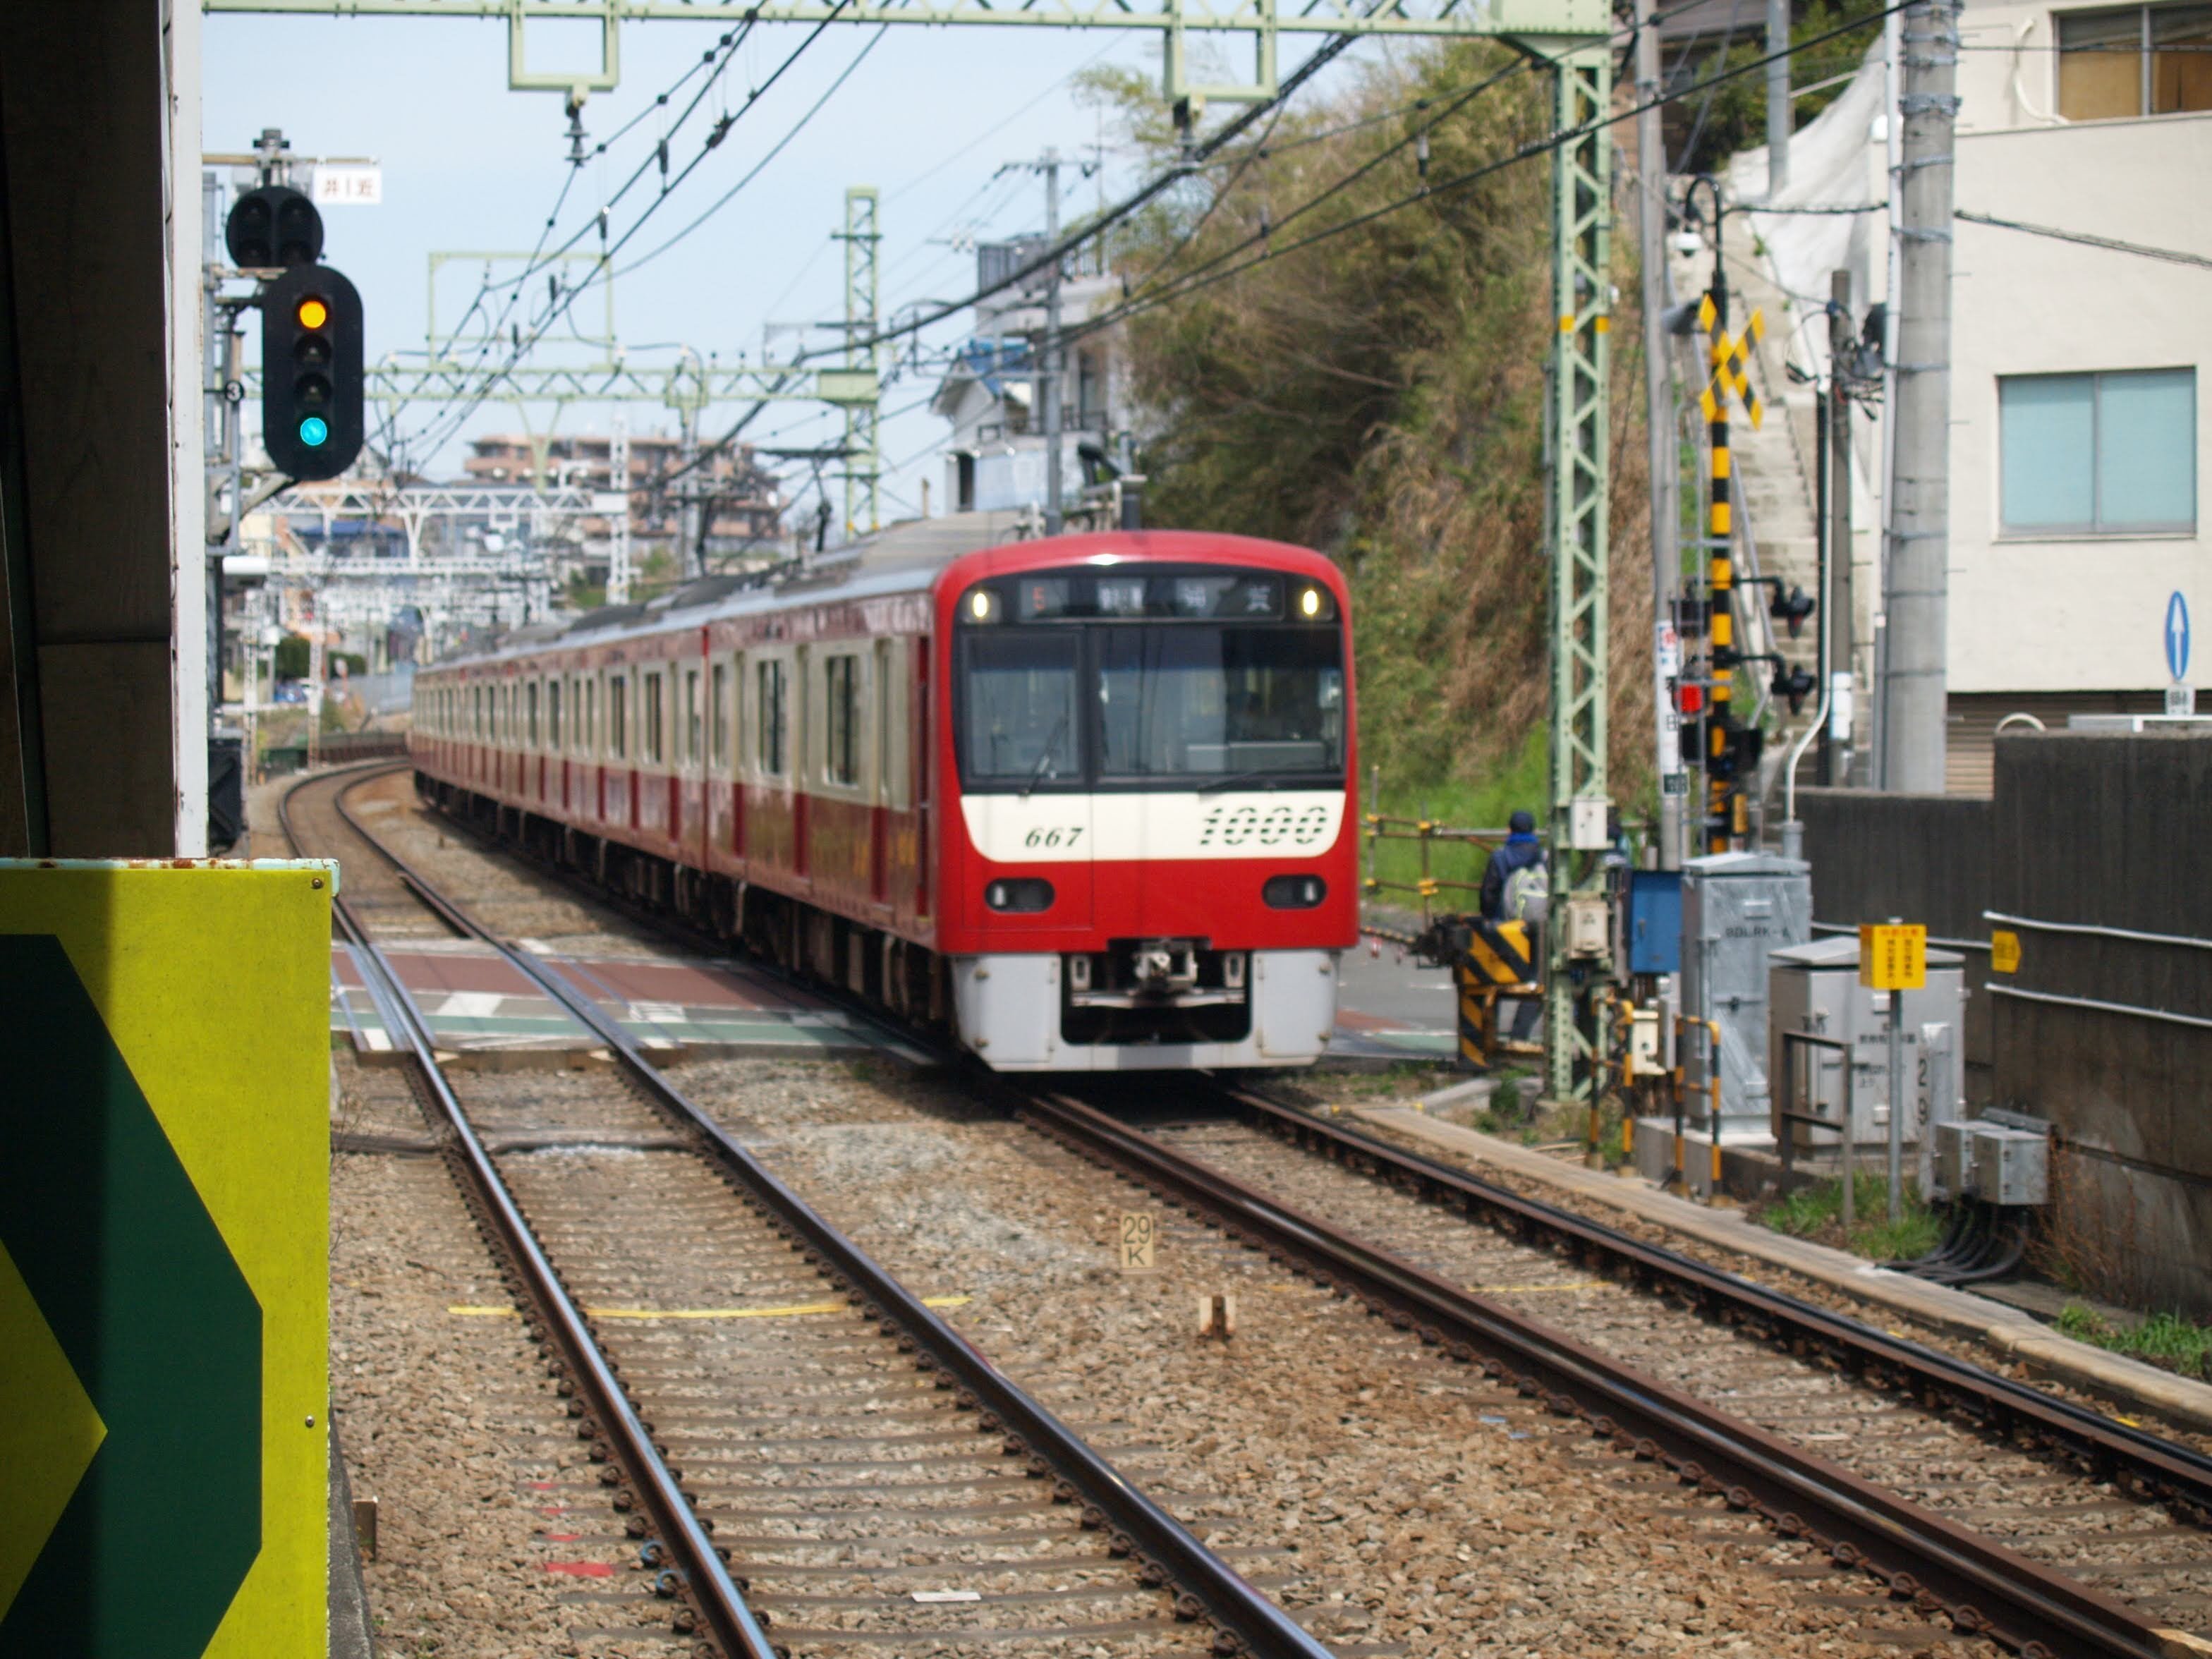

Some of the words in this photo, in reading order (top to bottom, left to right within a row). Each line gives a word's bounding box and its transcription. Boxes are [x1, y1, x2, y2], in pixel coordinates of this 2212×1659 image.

[1025, 827, 1084, 849] 667
[1198, 806, 1328, 846] 1000
[1123, 1215, 1151, 1245] 29
[1128, 1246, 1146, 1265] K
